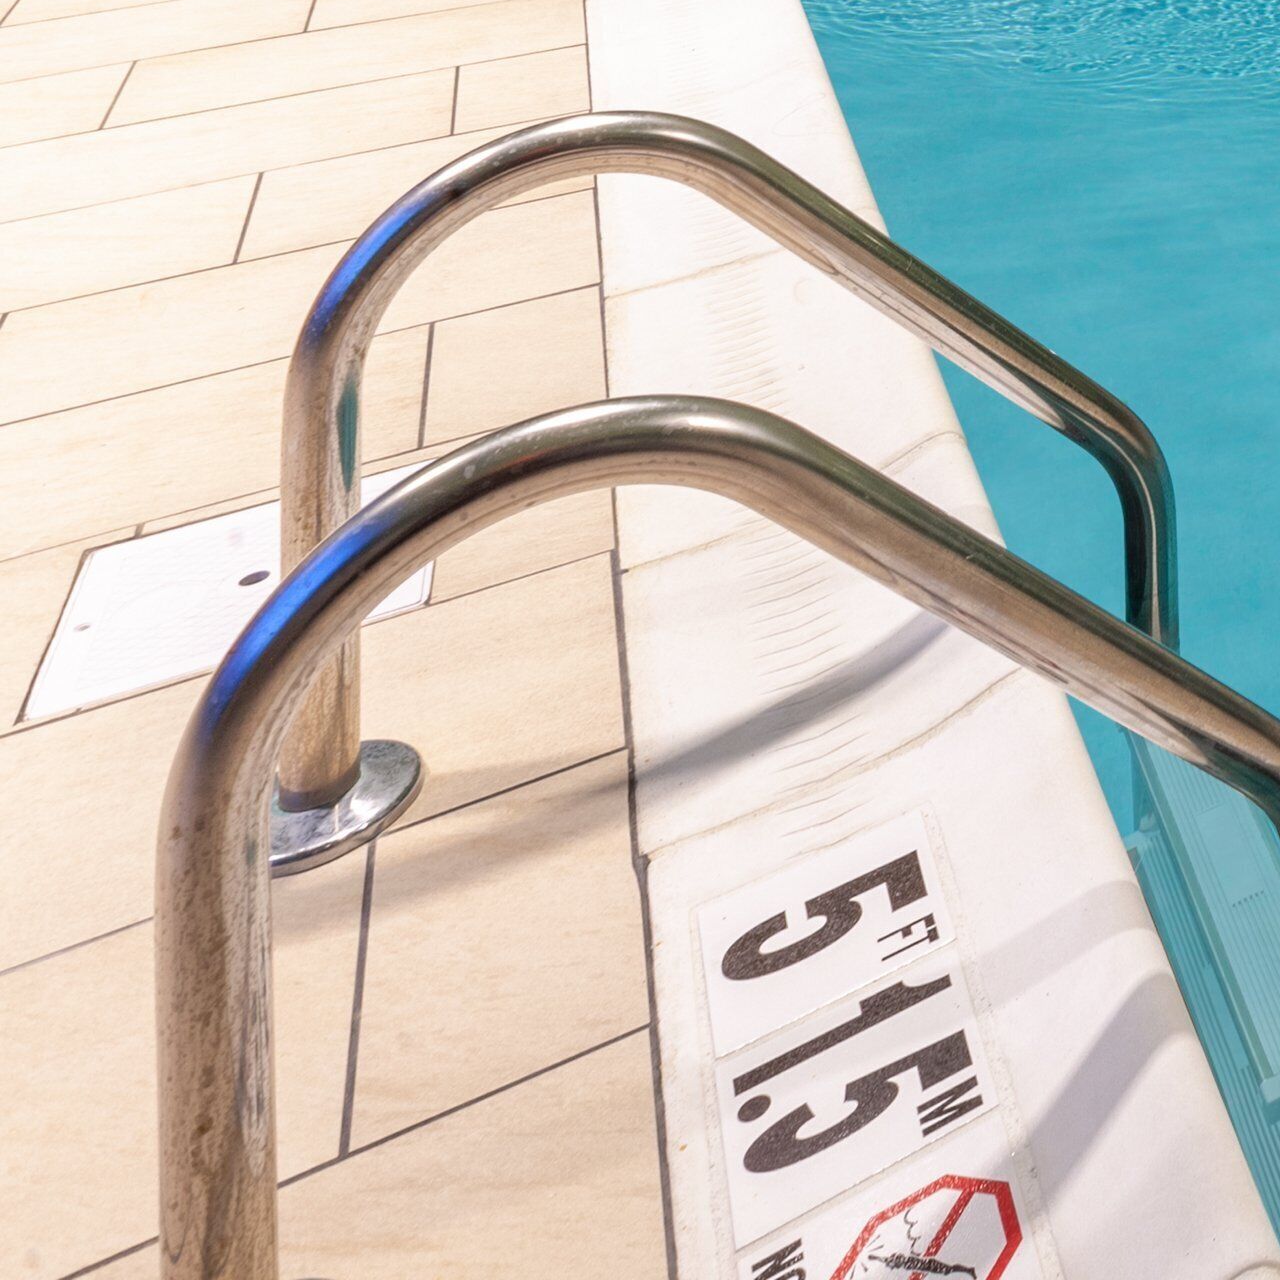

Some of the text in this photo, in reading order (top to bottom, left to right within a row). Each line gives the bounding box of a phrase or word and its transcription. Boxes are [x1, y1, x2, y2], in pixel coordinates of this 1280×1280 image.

[721, 849, 984, 1173] 5 FT 1.5 M
